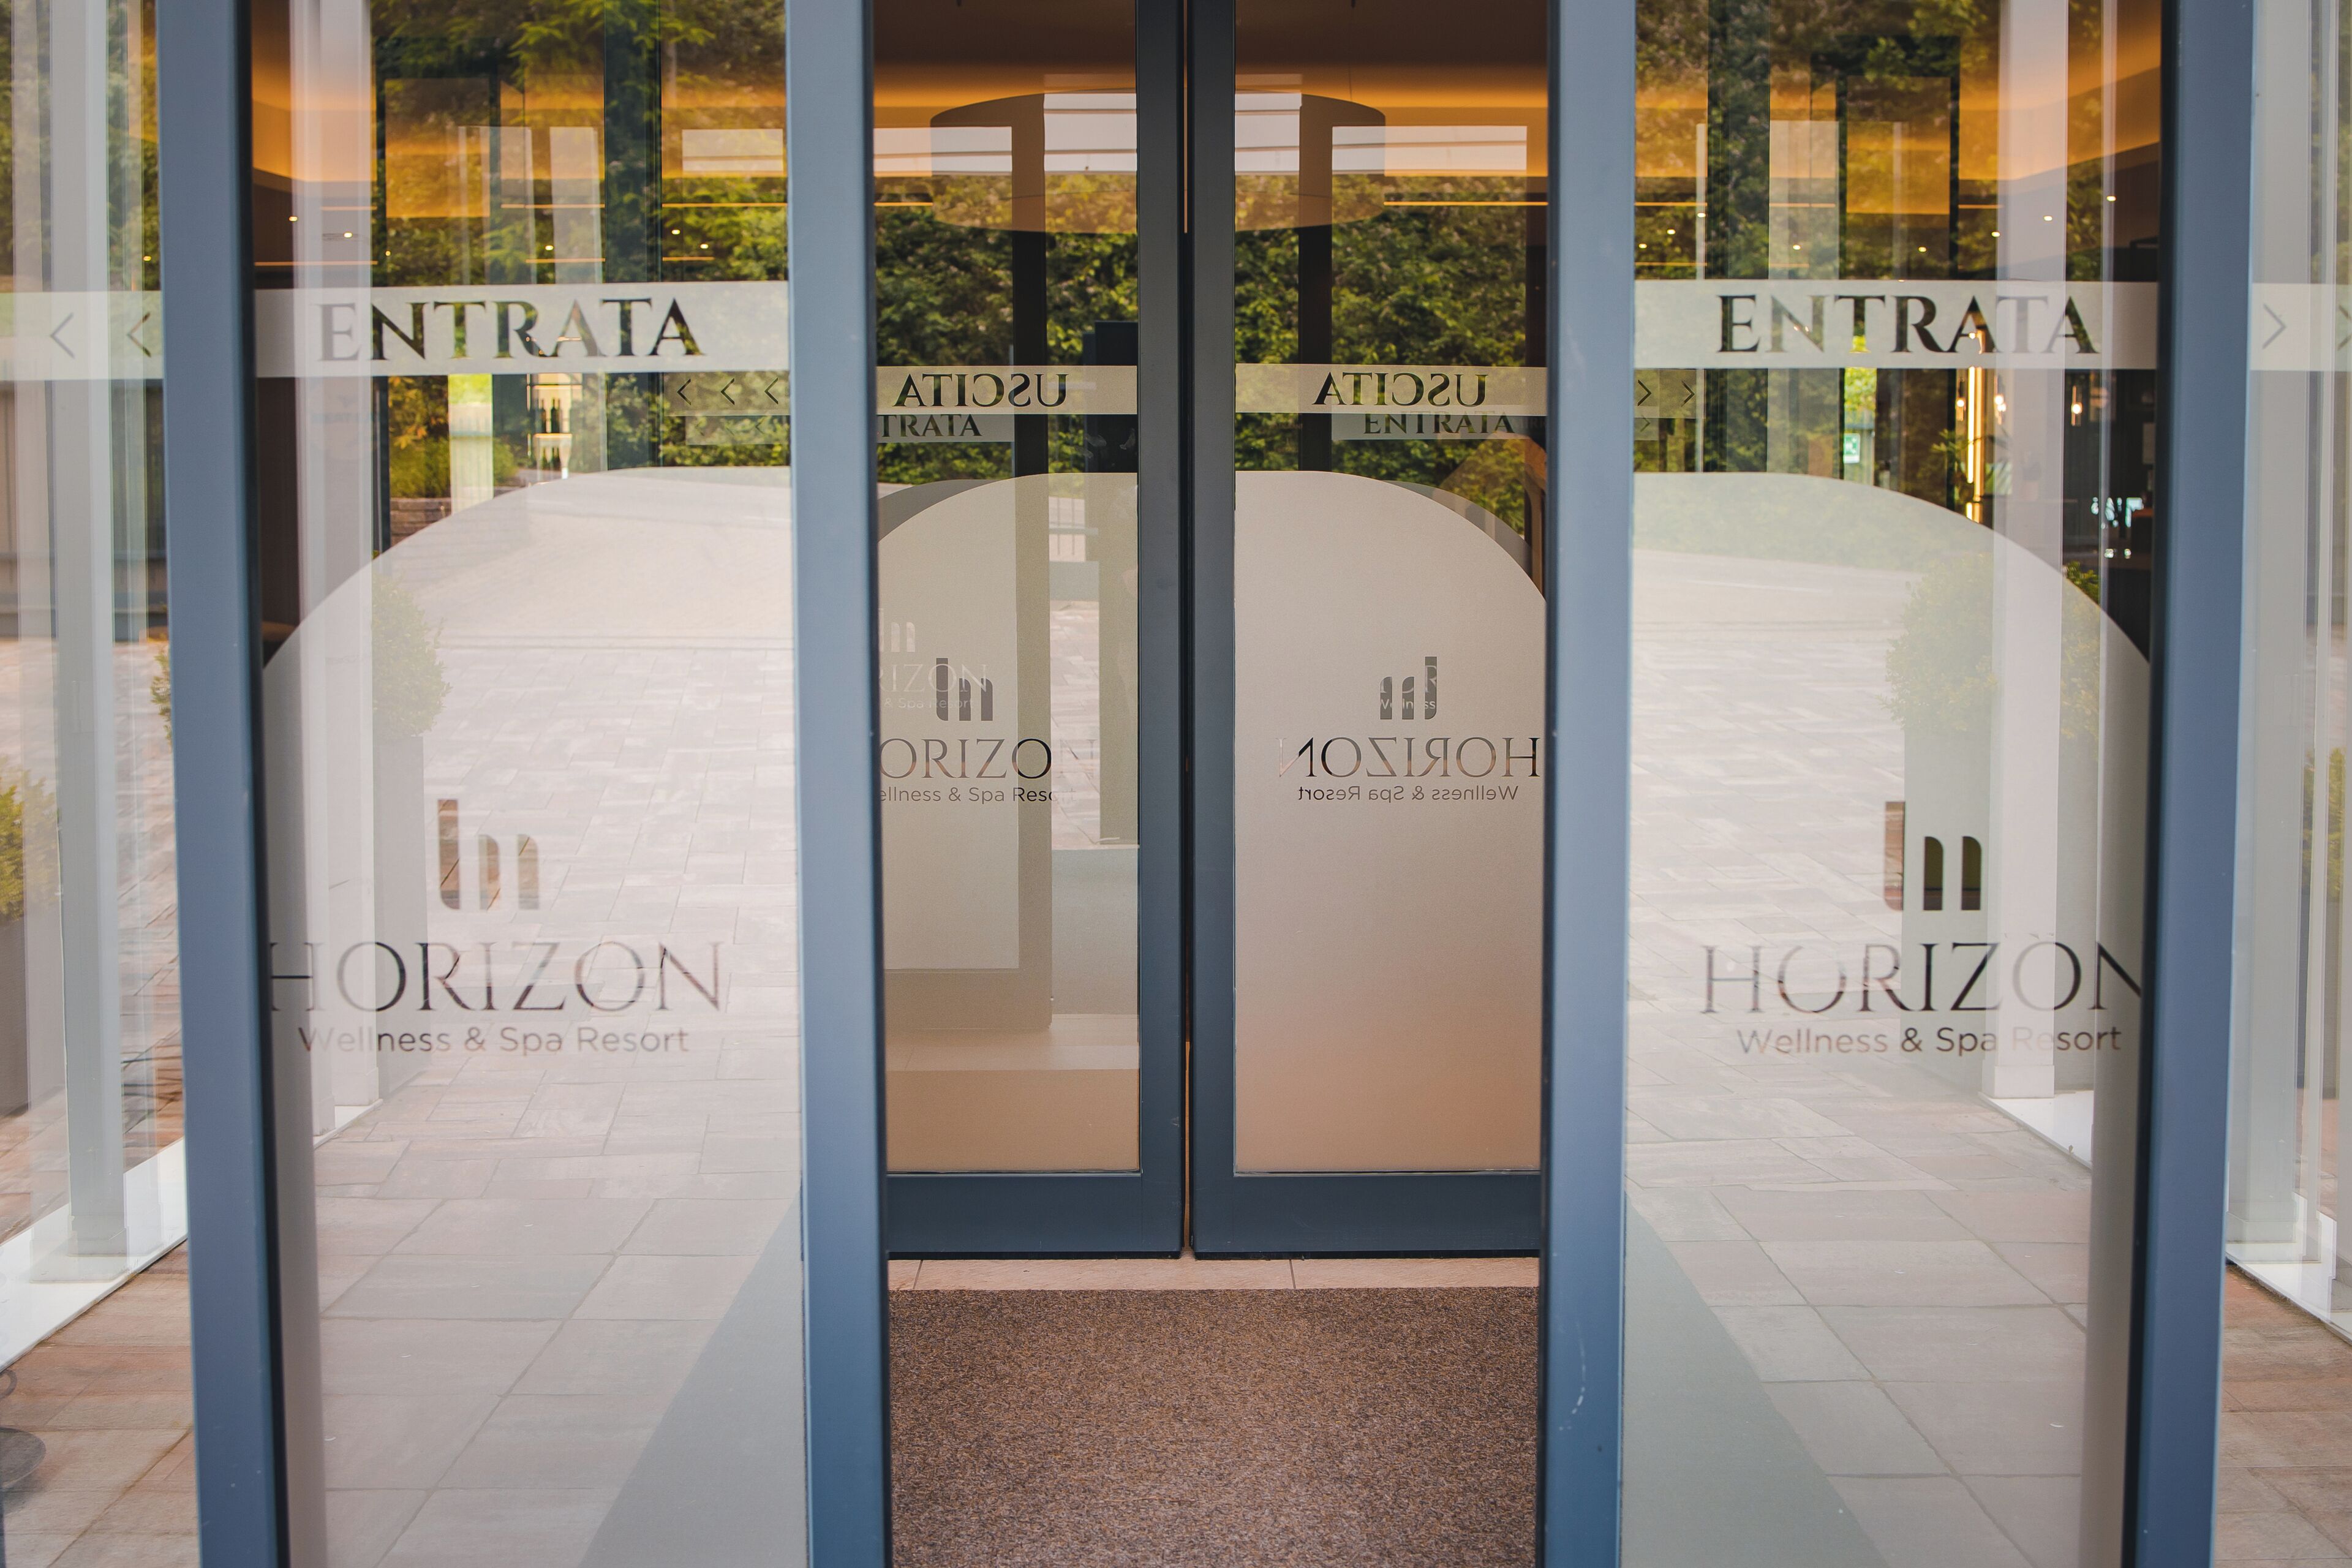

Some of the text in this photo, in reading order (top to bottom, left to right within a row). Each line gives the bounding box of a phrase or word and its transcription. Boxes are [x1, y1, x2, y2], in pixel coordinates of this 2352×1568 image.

[317, 298, 707, 361] ENTRATA
[1717, 295, 2100, 354] ENTRATA
[1363, 411, 1516, 434] ENTRATA
[949, 787, 961, 802] &
[969, 787, 1004, 804] Spa
[271, 941, 724, 1012] HORIZON
[1701, 941, 2142, 1013] HORIZON
[298, 1026, 690, 1056] Wellness & Spa Resort
[1737, 1026, 2122, 1057] Wellness & Spa Resort
